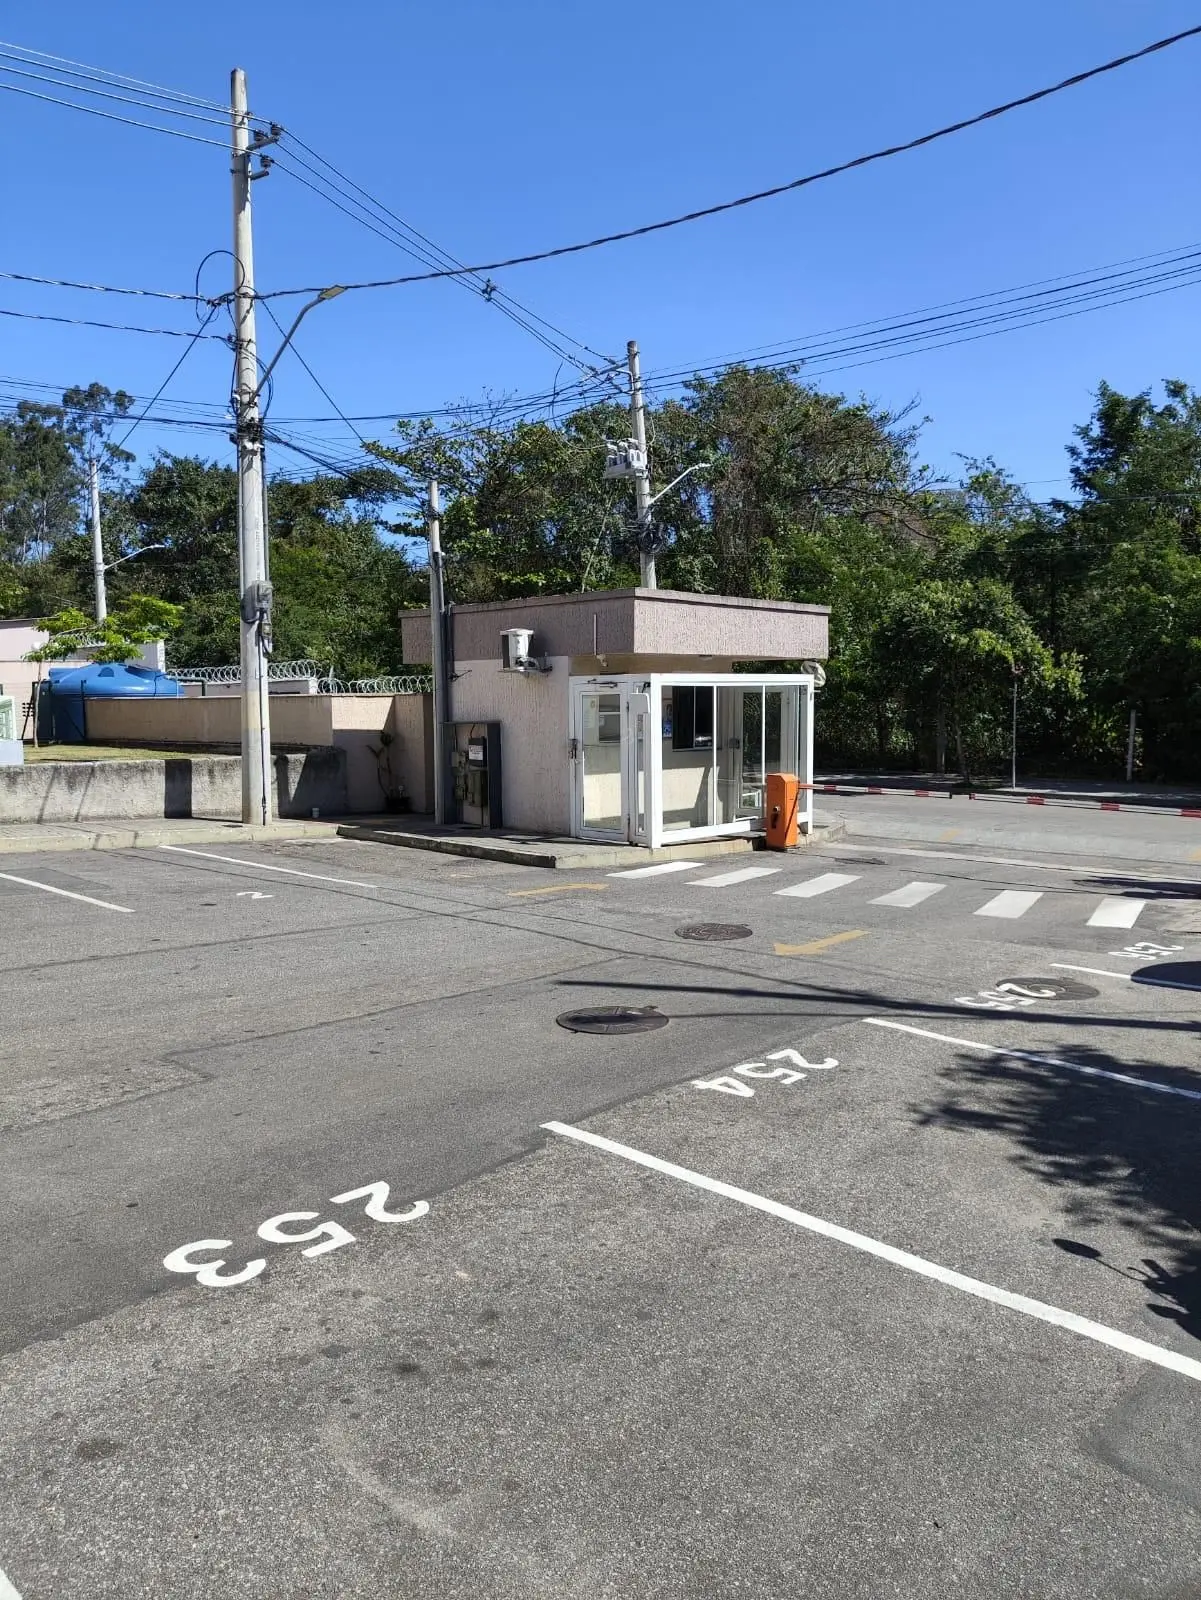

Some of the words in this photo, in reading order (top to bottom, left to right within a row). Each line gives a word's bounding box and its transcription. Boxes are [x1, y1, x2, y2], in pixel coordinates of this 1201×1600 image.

[236, 891, 274, 900] 2
[1107, 941, 1185, 961] 256
[954, 982, 1057, 1011] 255
[690, 1048, 839, 1098] 254
[163, 1181, 430, 1288] 253
